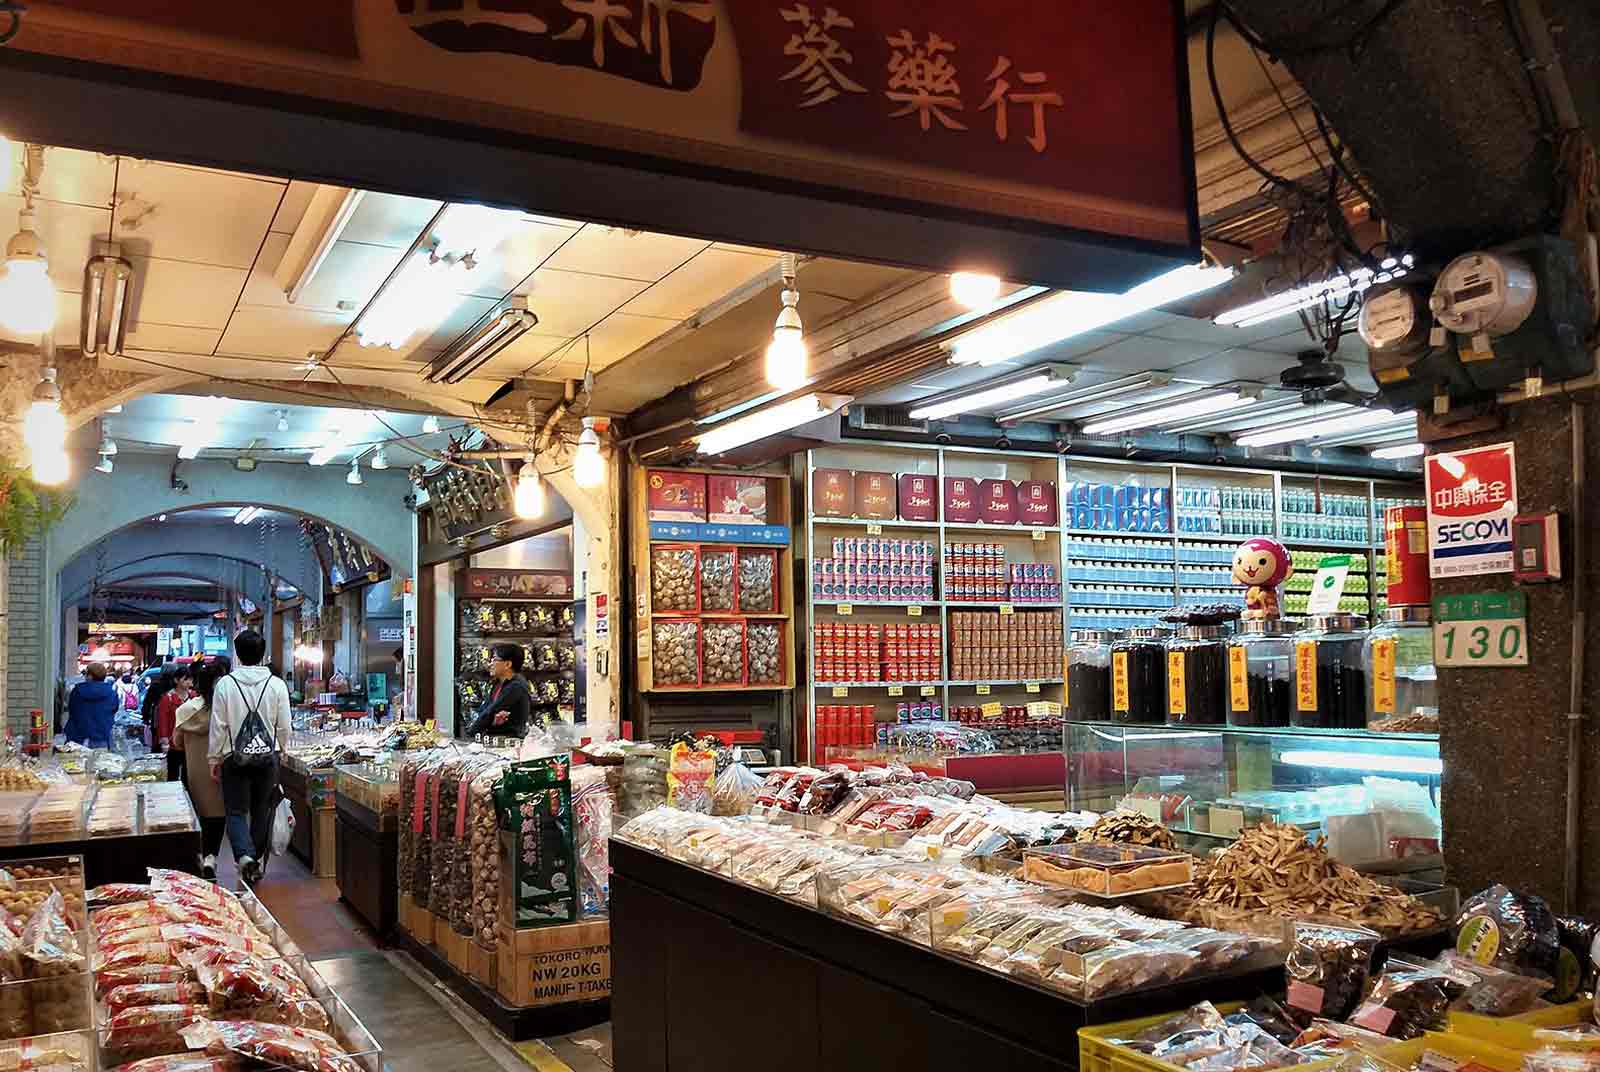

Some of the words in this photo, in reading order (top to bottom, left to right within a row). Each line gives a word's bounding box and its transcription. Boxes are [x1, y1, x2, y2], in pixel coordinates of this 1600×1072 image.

[1435, 481, 1508, 510] 中興保全
[1437, 518, 1509, 544] SECOM
[1442, 625, 1521, 659] 130
[560, 961, 601, 979] 20KG
